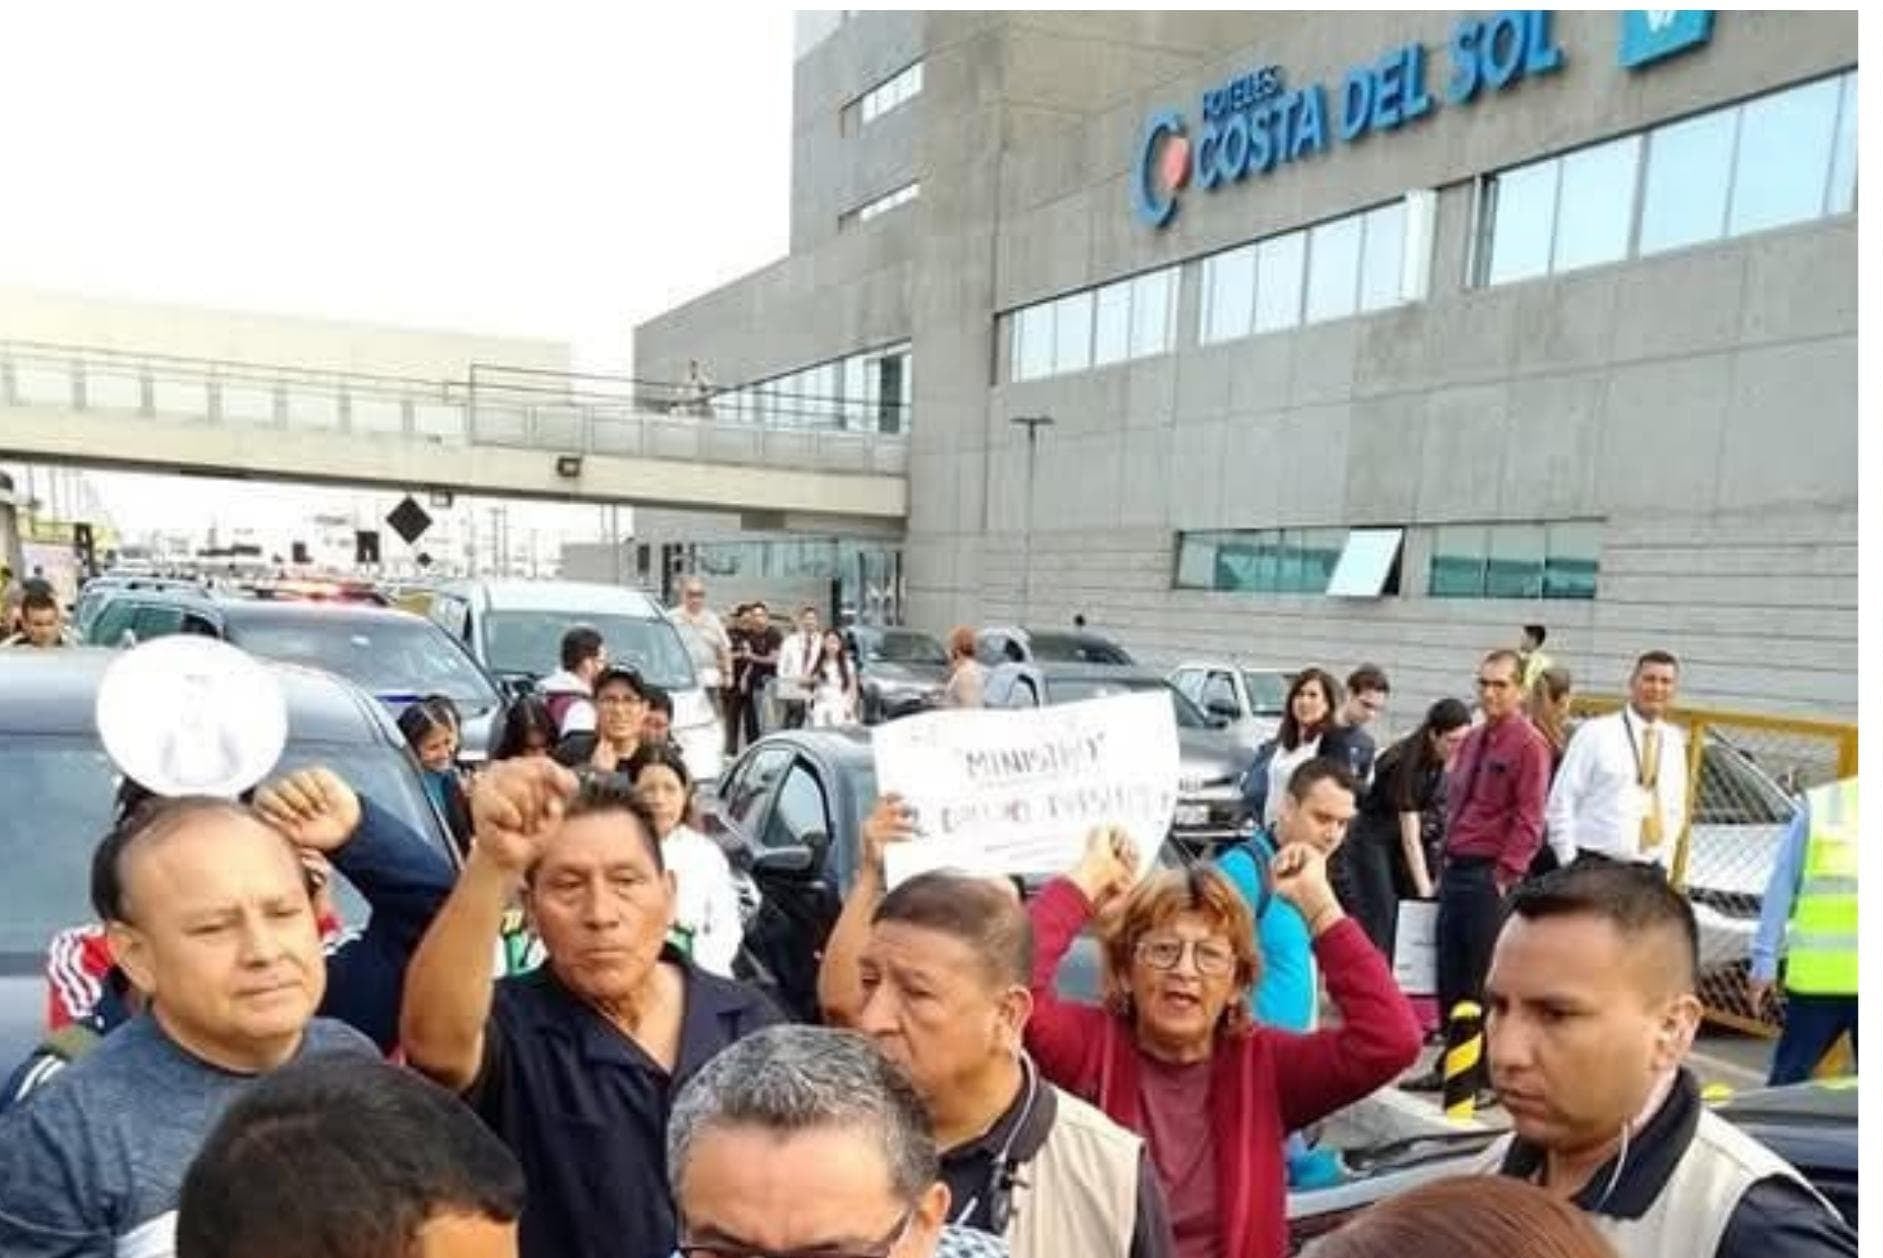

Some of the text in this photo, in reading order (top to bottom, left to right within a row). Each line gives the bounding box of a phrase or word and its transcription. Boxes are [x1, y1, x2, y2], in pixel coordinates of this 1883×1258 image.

[1196, 10, 1566, 190] COSTA DEL SOL
